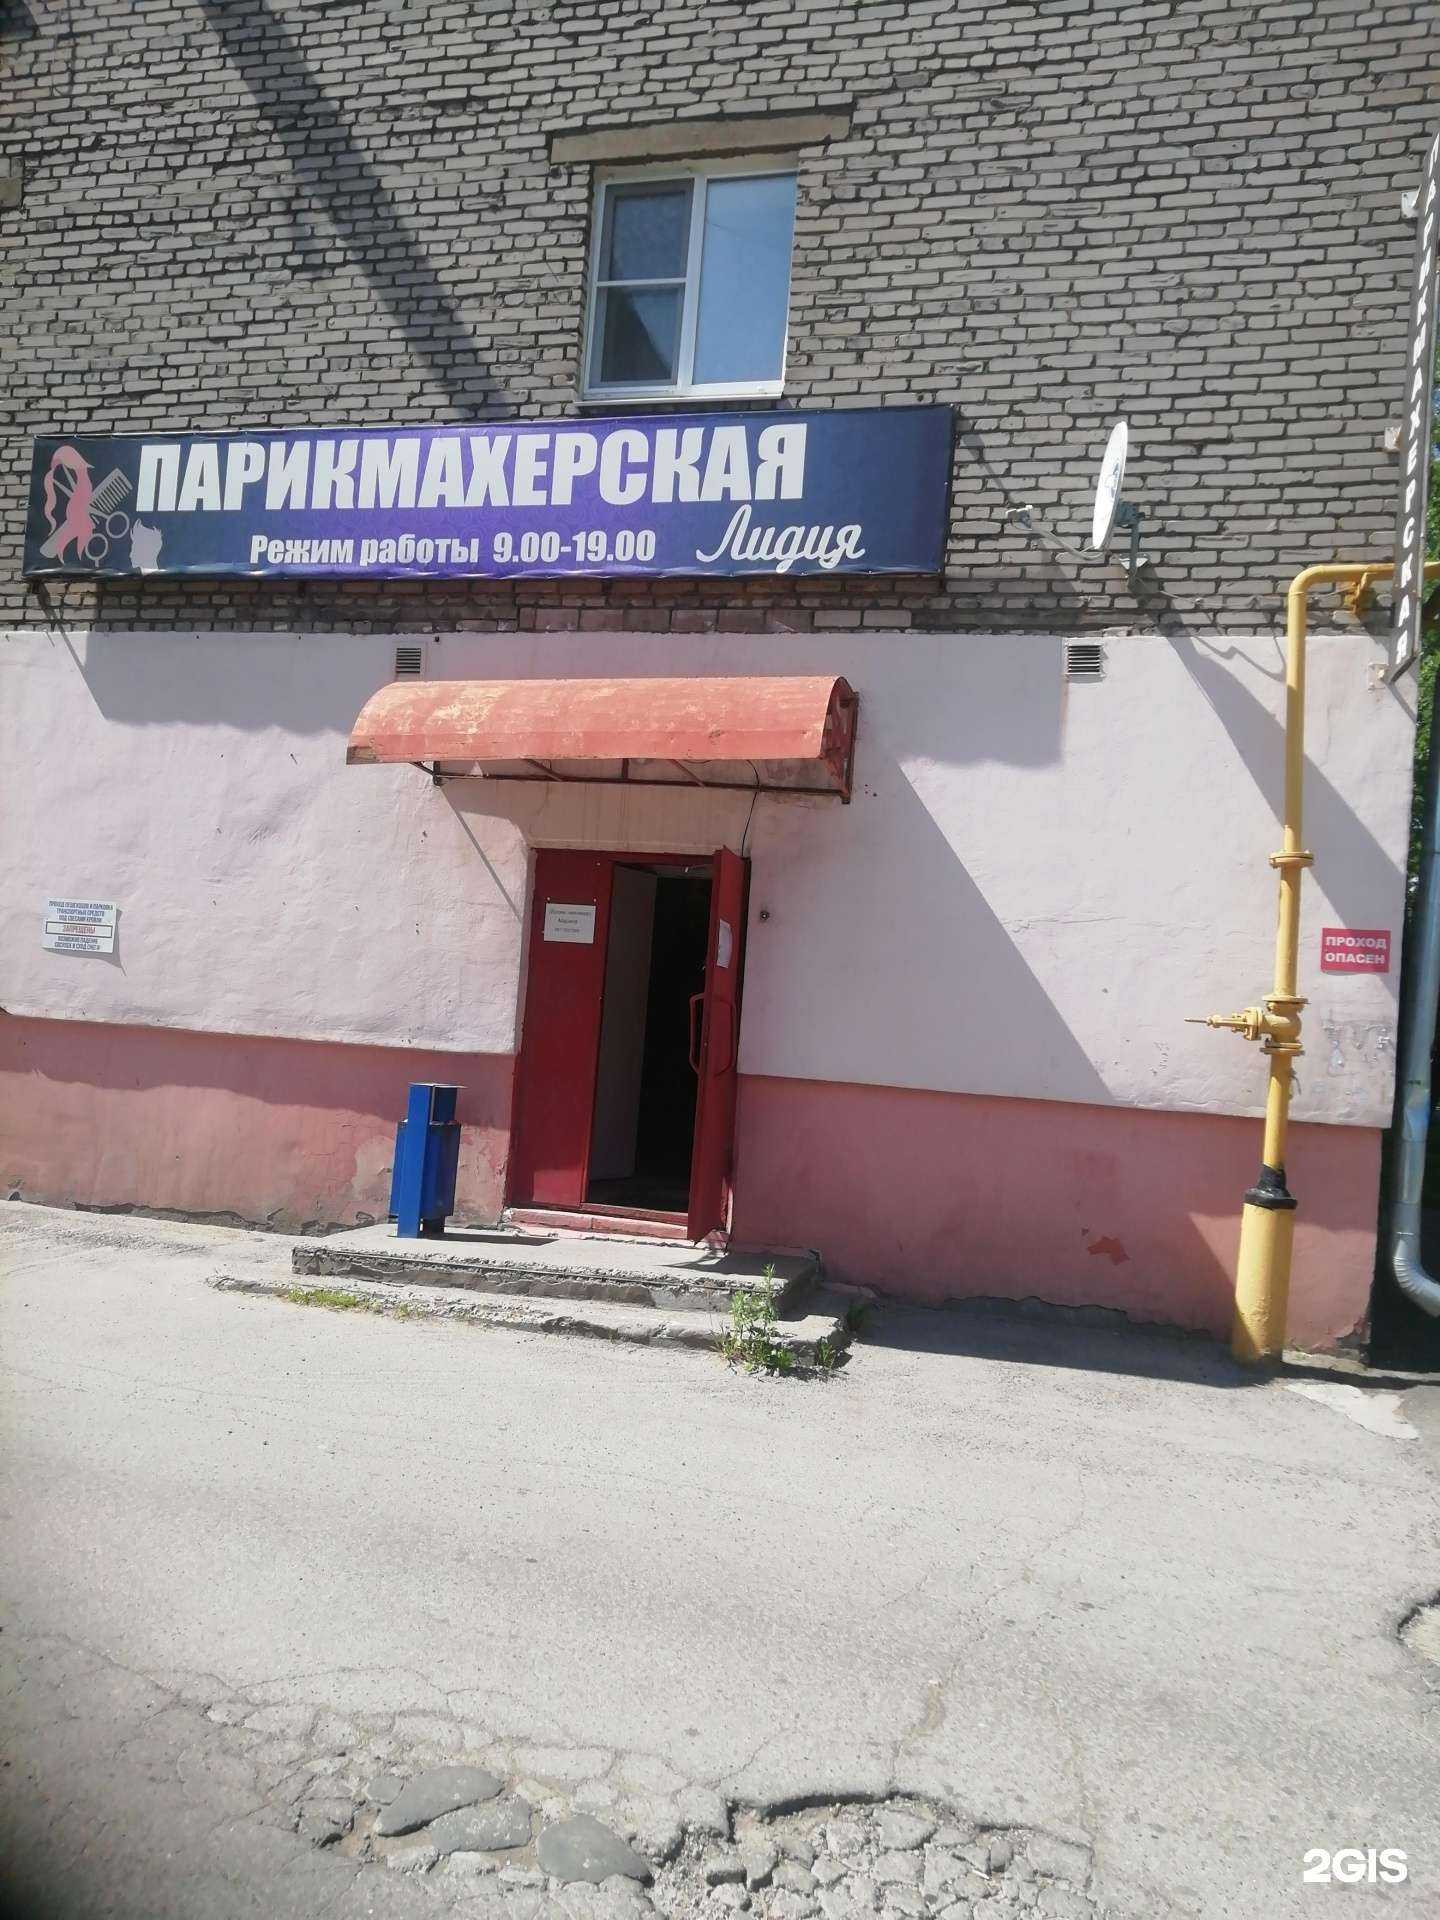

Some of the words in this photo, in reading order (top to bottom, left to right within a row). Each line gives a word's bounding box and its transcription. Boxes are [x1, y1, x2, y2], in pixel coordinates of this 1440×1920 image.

[1396, 132, 1440, 664] ПАРИКМАХЕРСКАЯ
[136, 422, 807, 512] ПАРИКМАХЕРСКАЯ
[250, 534, 354, 565] Режим
[360, 533, 480, 566] работы
[493, 530, 656, 563] 9.00-19.00
[696, 504, 866, 573] Лидия
[63, 924, 96, 934] ЗАПРЕЩЕНЫ
[1326, 936, 1386, 950] ПРОХОД
[1325, 952, 1385, 964] ОПАСЕН
